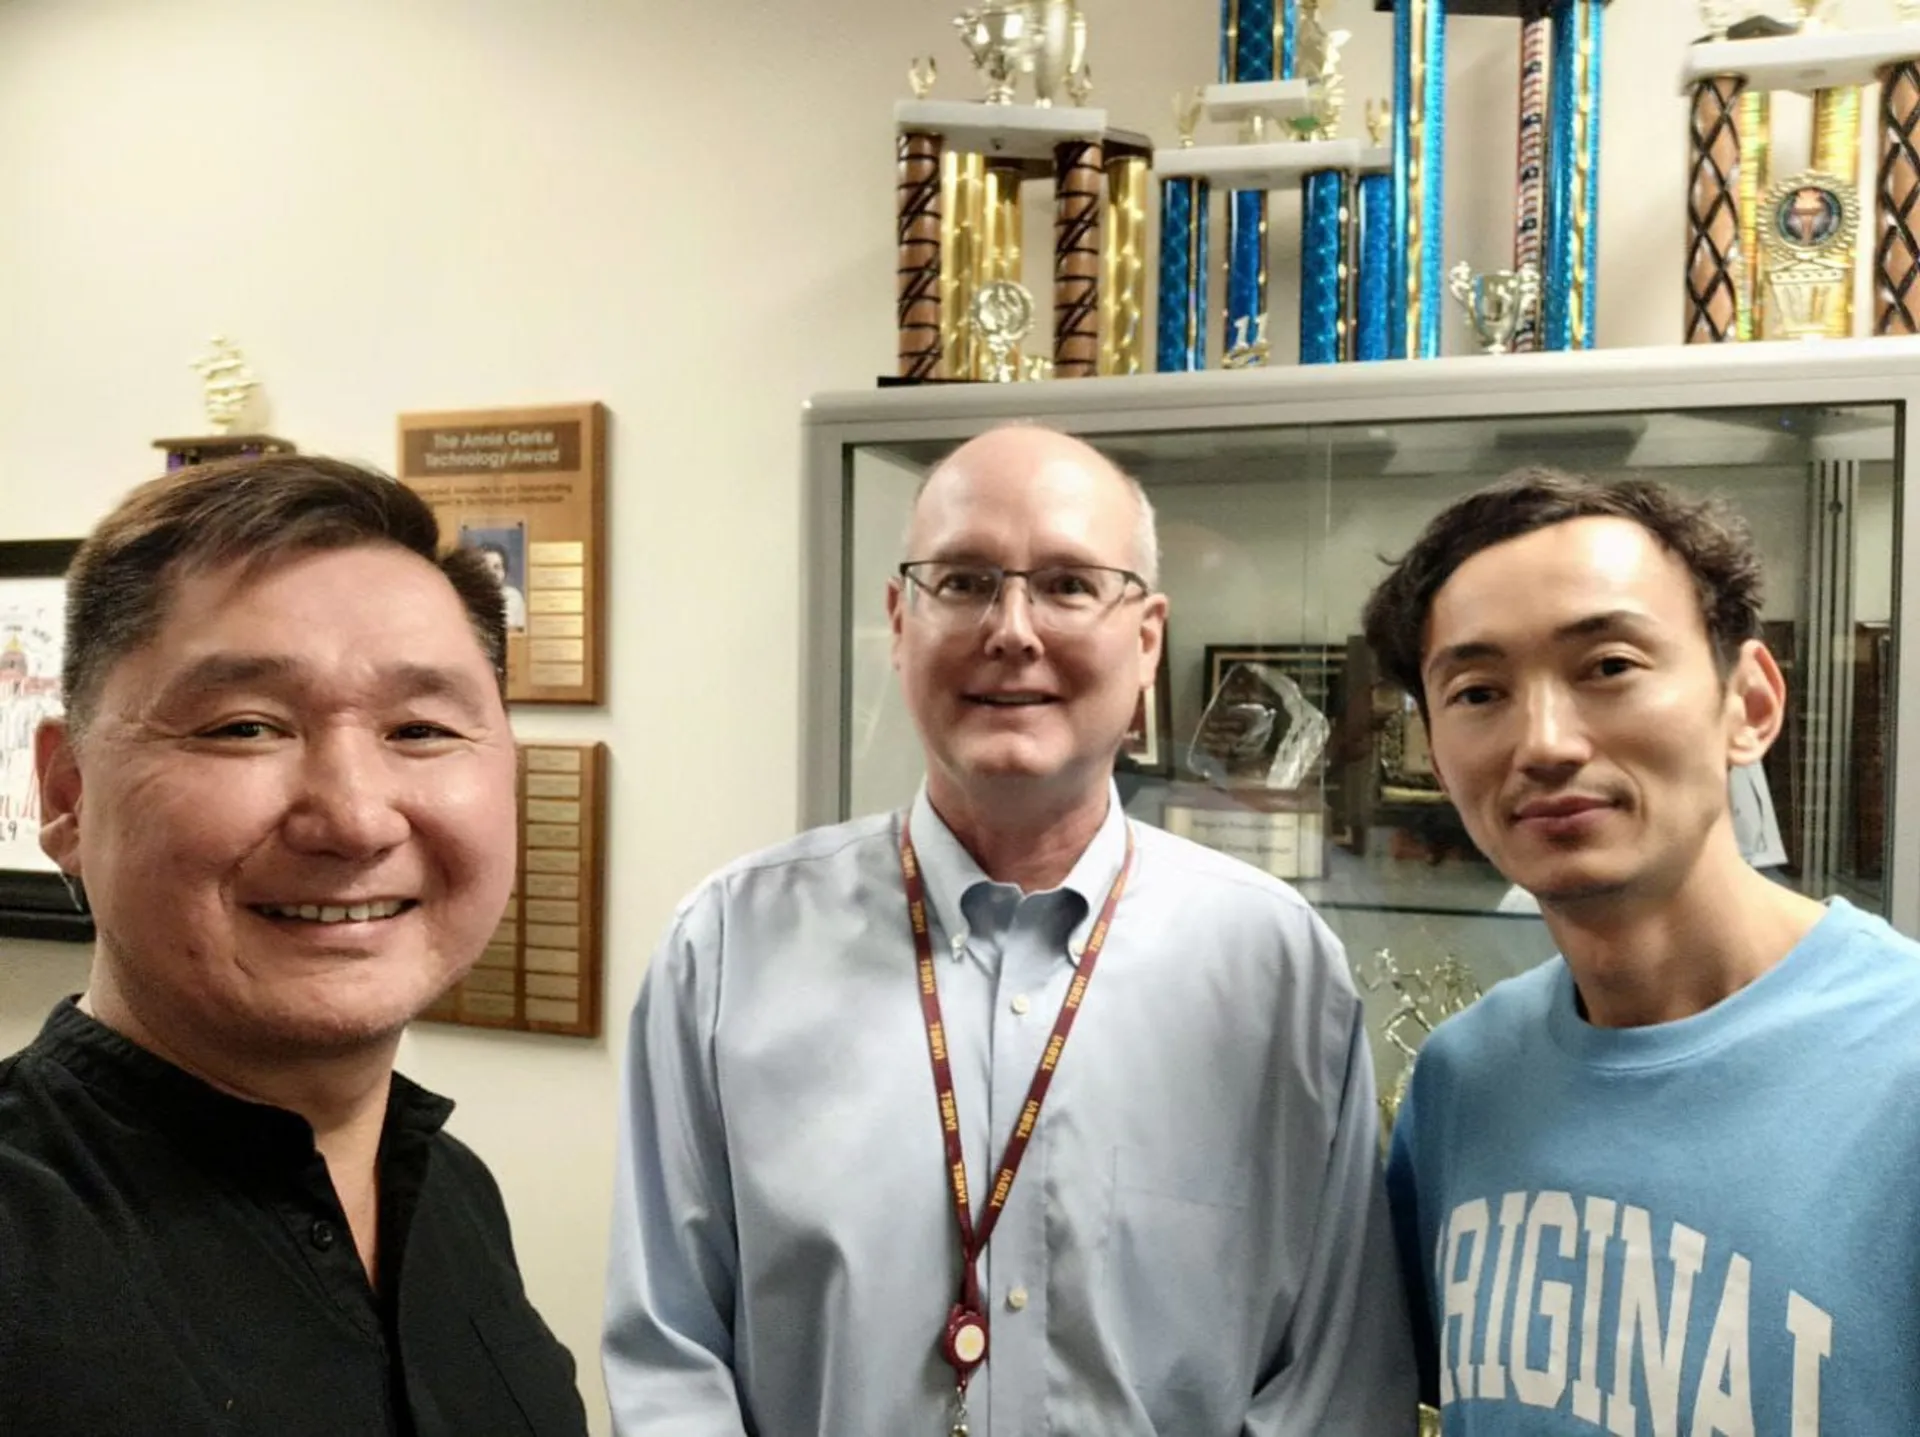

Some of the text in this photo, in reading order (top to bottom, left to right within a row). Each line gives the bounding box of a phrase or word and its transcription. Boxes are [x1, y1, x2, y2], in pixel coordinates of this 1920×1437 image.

[434, 433, 459, 448] The
[462, 432, 504, 448] Annie
[425, 448, 560, 468] Technology Award
